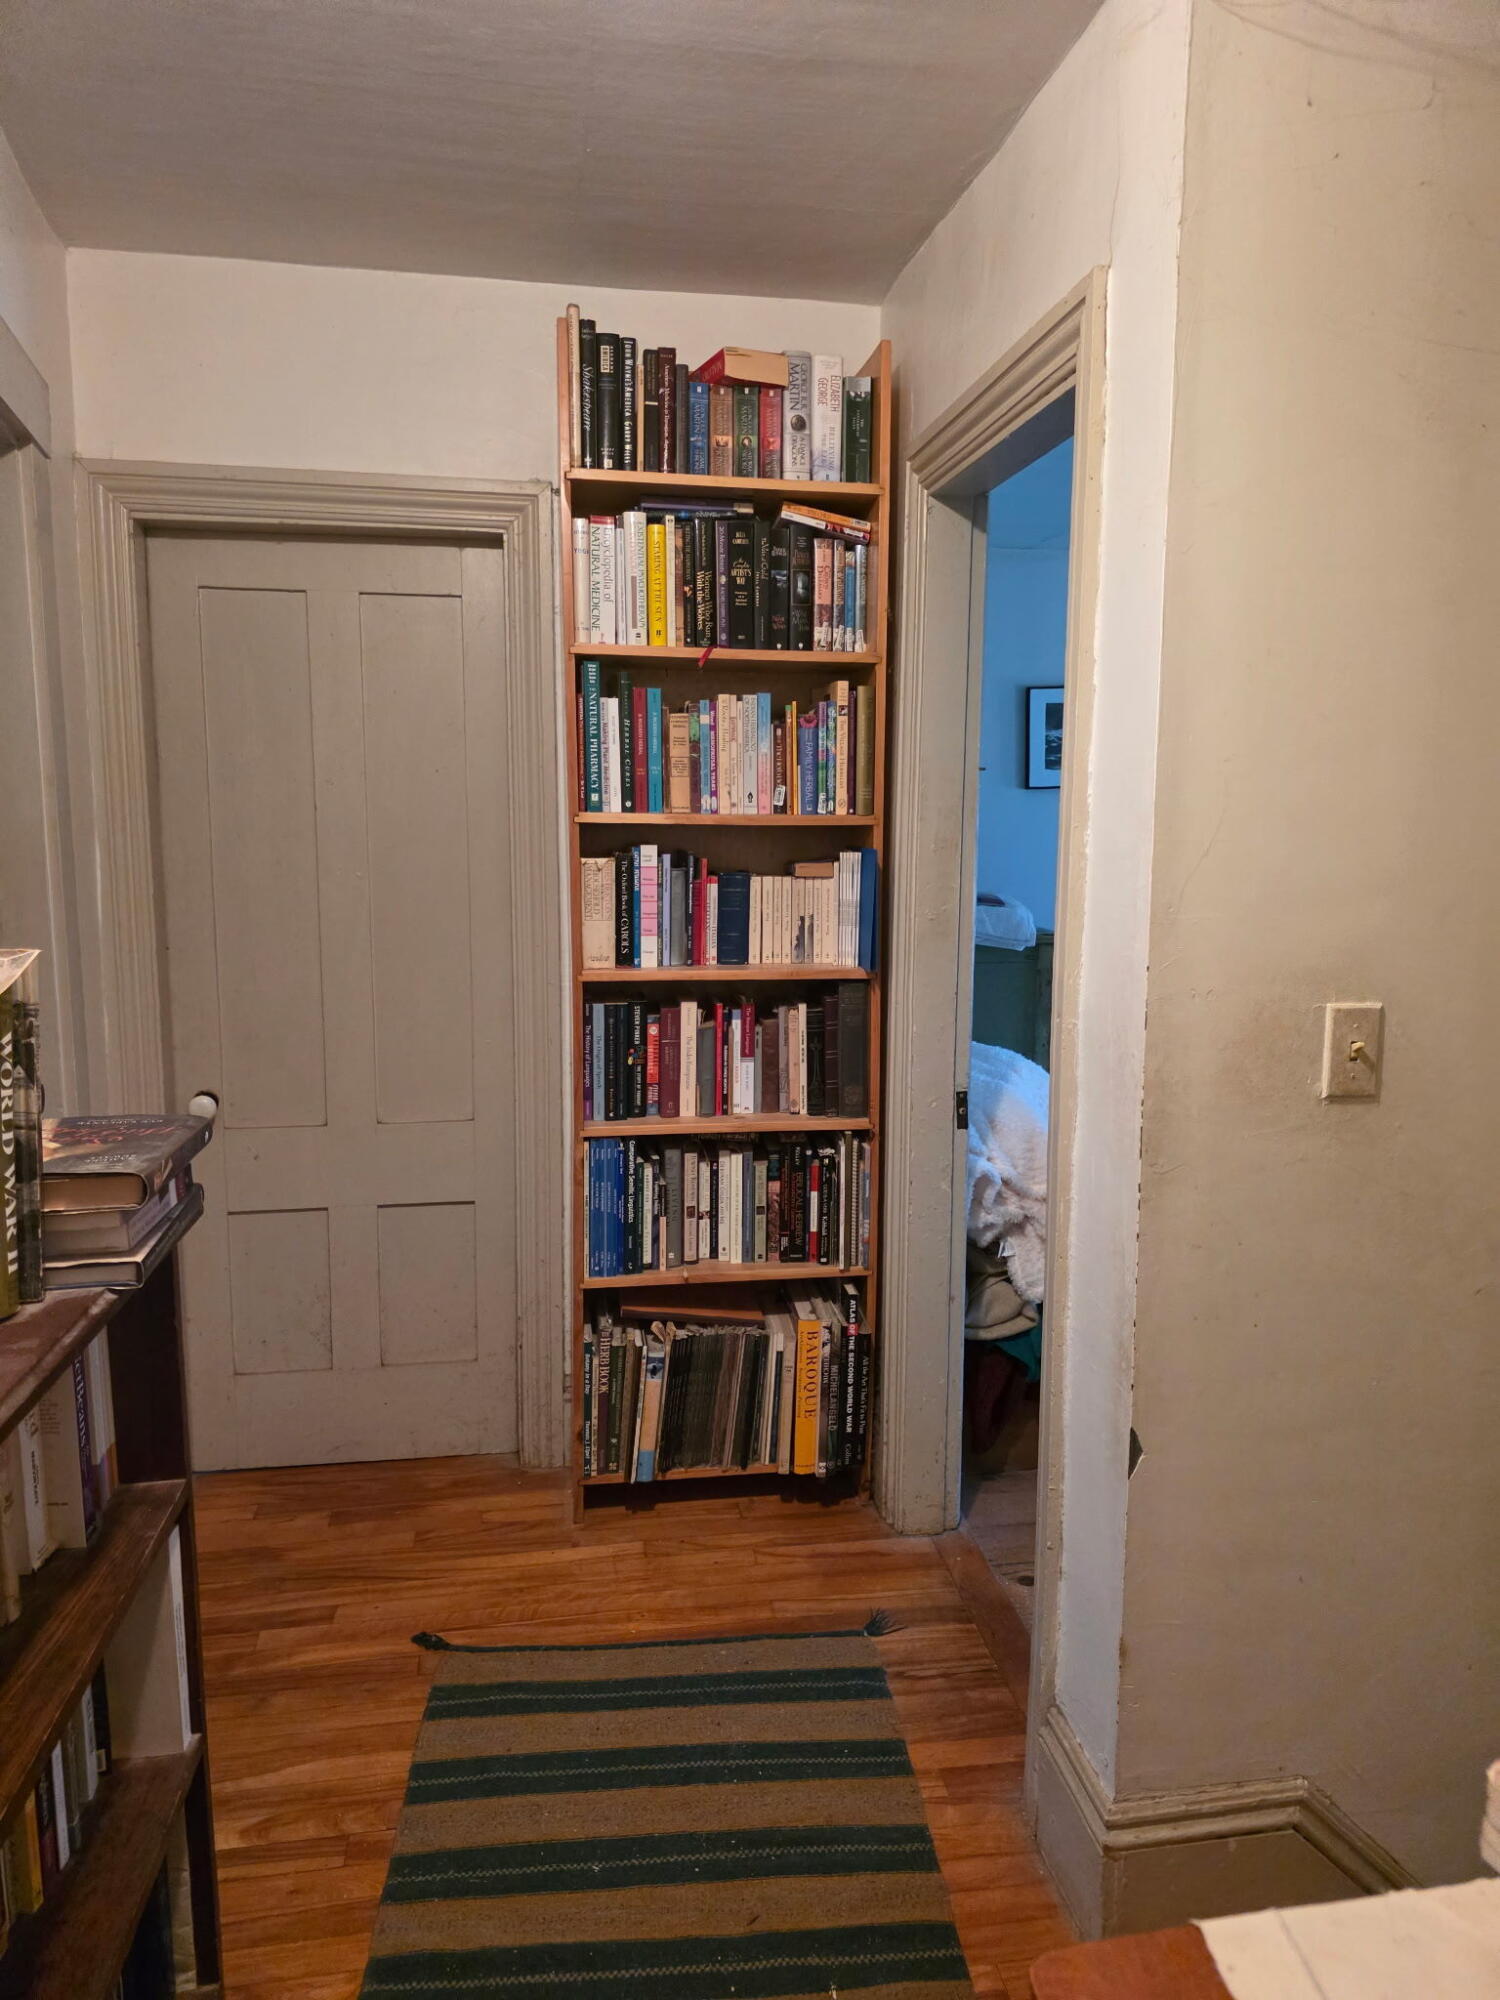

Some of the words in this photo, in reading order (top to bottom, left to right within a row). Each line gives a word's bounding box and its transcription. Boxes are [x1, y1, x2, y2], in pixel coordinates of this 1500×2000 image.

[624, 341, 632, 357] JOHN
[625, 359, 633, 386] WAYNE'S
[789, 363, 800, 411] MARTIN
[583, 363, 594, 432] Shakespeare
[625, 386, 634, 416] AMERICA
[817, 378, 828, 407] GEORGE
[831, 376, 842, 412] ELIZABETH
[591, 526, 601, 577] NATURAL
[601, 526, 613, 592] Encyclopedia
[654, 541, 662, 574] STARING
[697, 571, 705, 590] With
[704, 571, 713, 601] Women
[731, 569, 751, 577] ARTIST'S
[591, 580, 601, 632] MEDICINE
[603, 593, 613, 604] of
[705, 602, 713, 620] Who
[655, 606, 663, 623] SUN
[705, 621, 713, 639] Run
[589, 692, 599, 737] NATURAL
[624, 719, 632, 755] HERBAL
[591, 738, 600, 790] PHARMACY
[803, 742, 813, 770] FAMILY
[624, 759, 632, 788] CURES
[803, 771, 813, 802] HERBAL
[620, 918, 630, 954] CAROLS
[0, 1031, 14, 1156] WORLD
[628, 1140, 636, 1174] Comparative
[4, 1163, 18, 1242] WAR
[795, 1210, 803, 1246] HEBREW
[8, 1249, 19, 1276] II
[849, 1300, 857, 1323] ATLAS
[600, 1338, 610, 1365] HERB
[848, 1336, 856, 1351] THE
[599, 1366, 610, 1394] BOOK
[804, 1331, 819, 1420] BAROQUE
[828, 1365, 839, 1432] MICHELANGELO
[844, 1444, 852, 1465] Collins
